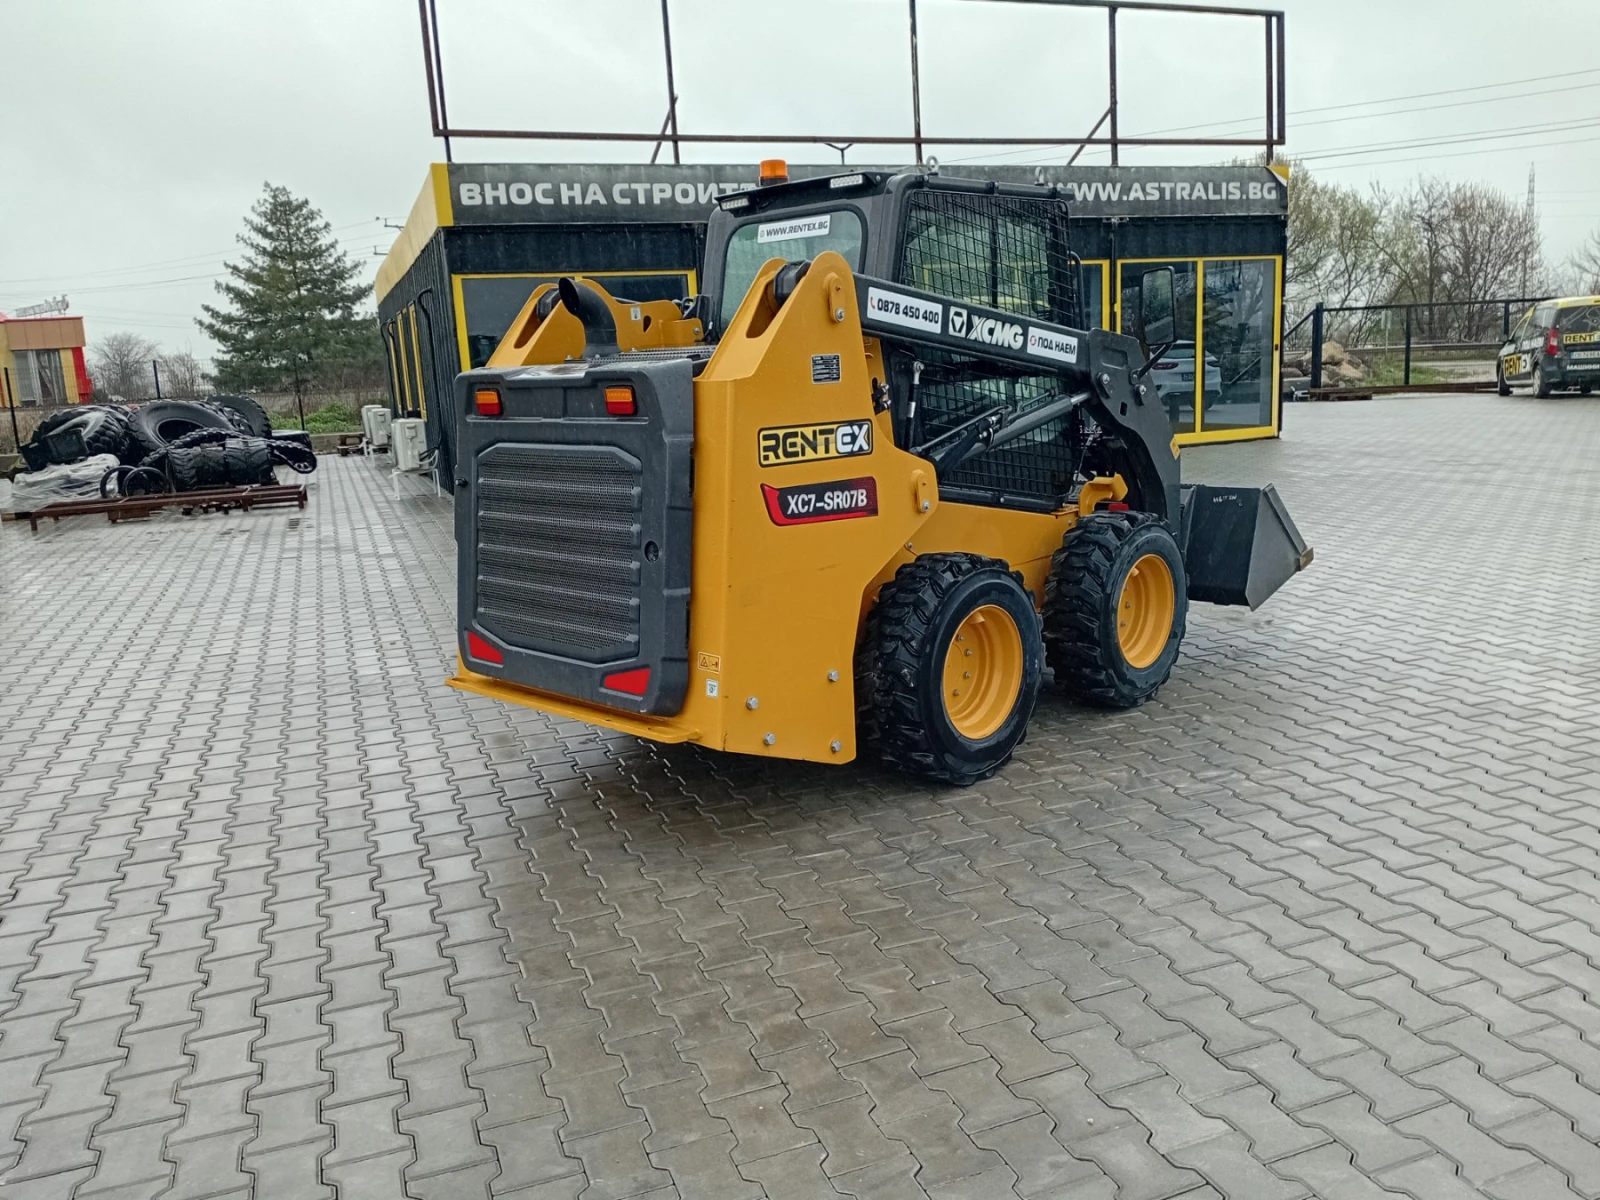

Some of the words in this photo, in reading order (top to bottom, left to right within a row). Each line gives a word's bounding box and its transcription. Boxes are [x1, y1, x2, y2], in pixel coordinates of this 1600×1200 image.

[459, 183, 554, 205] ВНОС
[560, 183, 607, 205] НА
[1048, 182, 1277, 201] WW.ASTRALIS.BG
[766, 221, 828, 237] WWW.RENTEX.BG
[877, 298, 900, 315] 0878
[902, 304, 920, 319] 450
[922, 309, 939, 324] 400
[967, 315, 1024, 350] XCMG
[1037, 338, 1054, 350] ПОД
[1055, 343, 1076, 355] НАЕМ
[762, 424, 869, 462] RENTEX
[786, 488, 868, 515] XC7-SR07B
